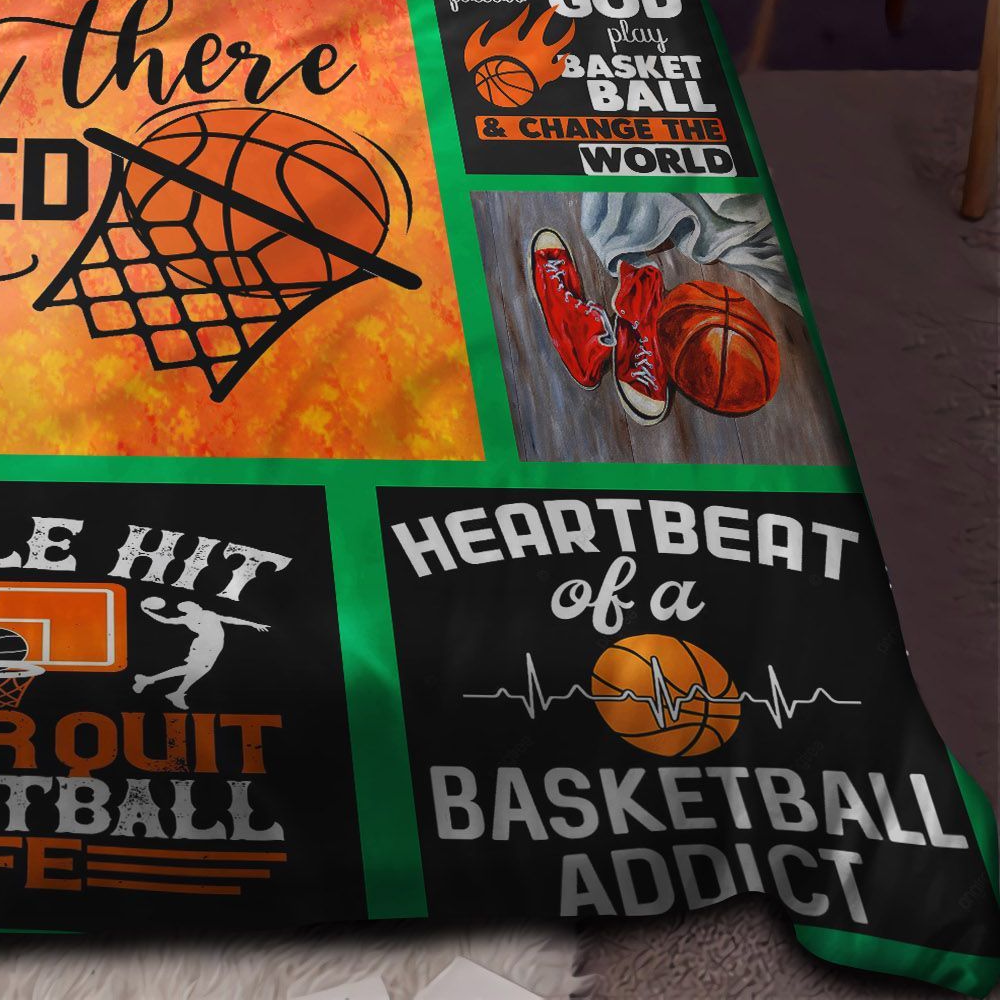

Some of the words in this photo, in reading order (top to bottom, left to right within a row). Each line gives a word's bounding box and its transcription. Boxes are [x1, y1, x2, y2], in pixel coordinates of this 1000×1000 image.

[556, 53, 701, 79] BASKET
[607, 19, 669, 53] play
[482, 117, 506, 139] &
[518, 117, 653, 140] CHANGE
[662, 118, 723, 140] THE
[586, 79, 717, 113] BALL
[580, 146, 734, 175] WORLD
[108, 524, 294, 602] HIT
[391, 498, 860, 580] HEARTBEAT
[551, 556, 637, 636] of
[649, 579, 706, 622] a
[54, 710, 283, 778] QUIT
[429, 765, 969, 850] BASKETBALL
[559, 841, 868, 925] ADDICT
